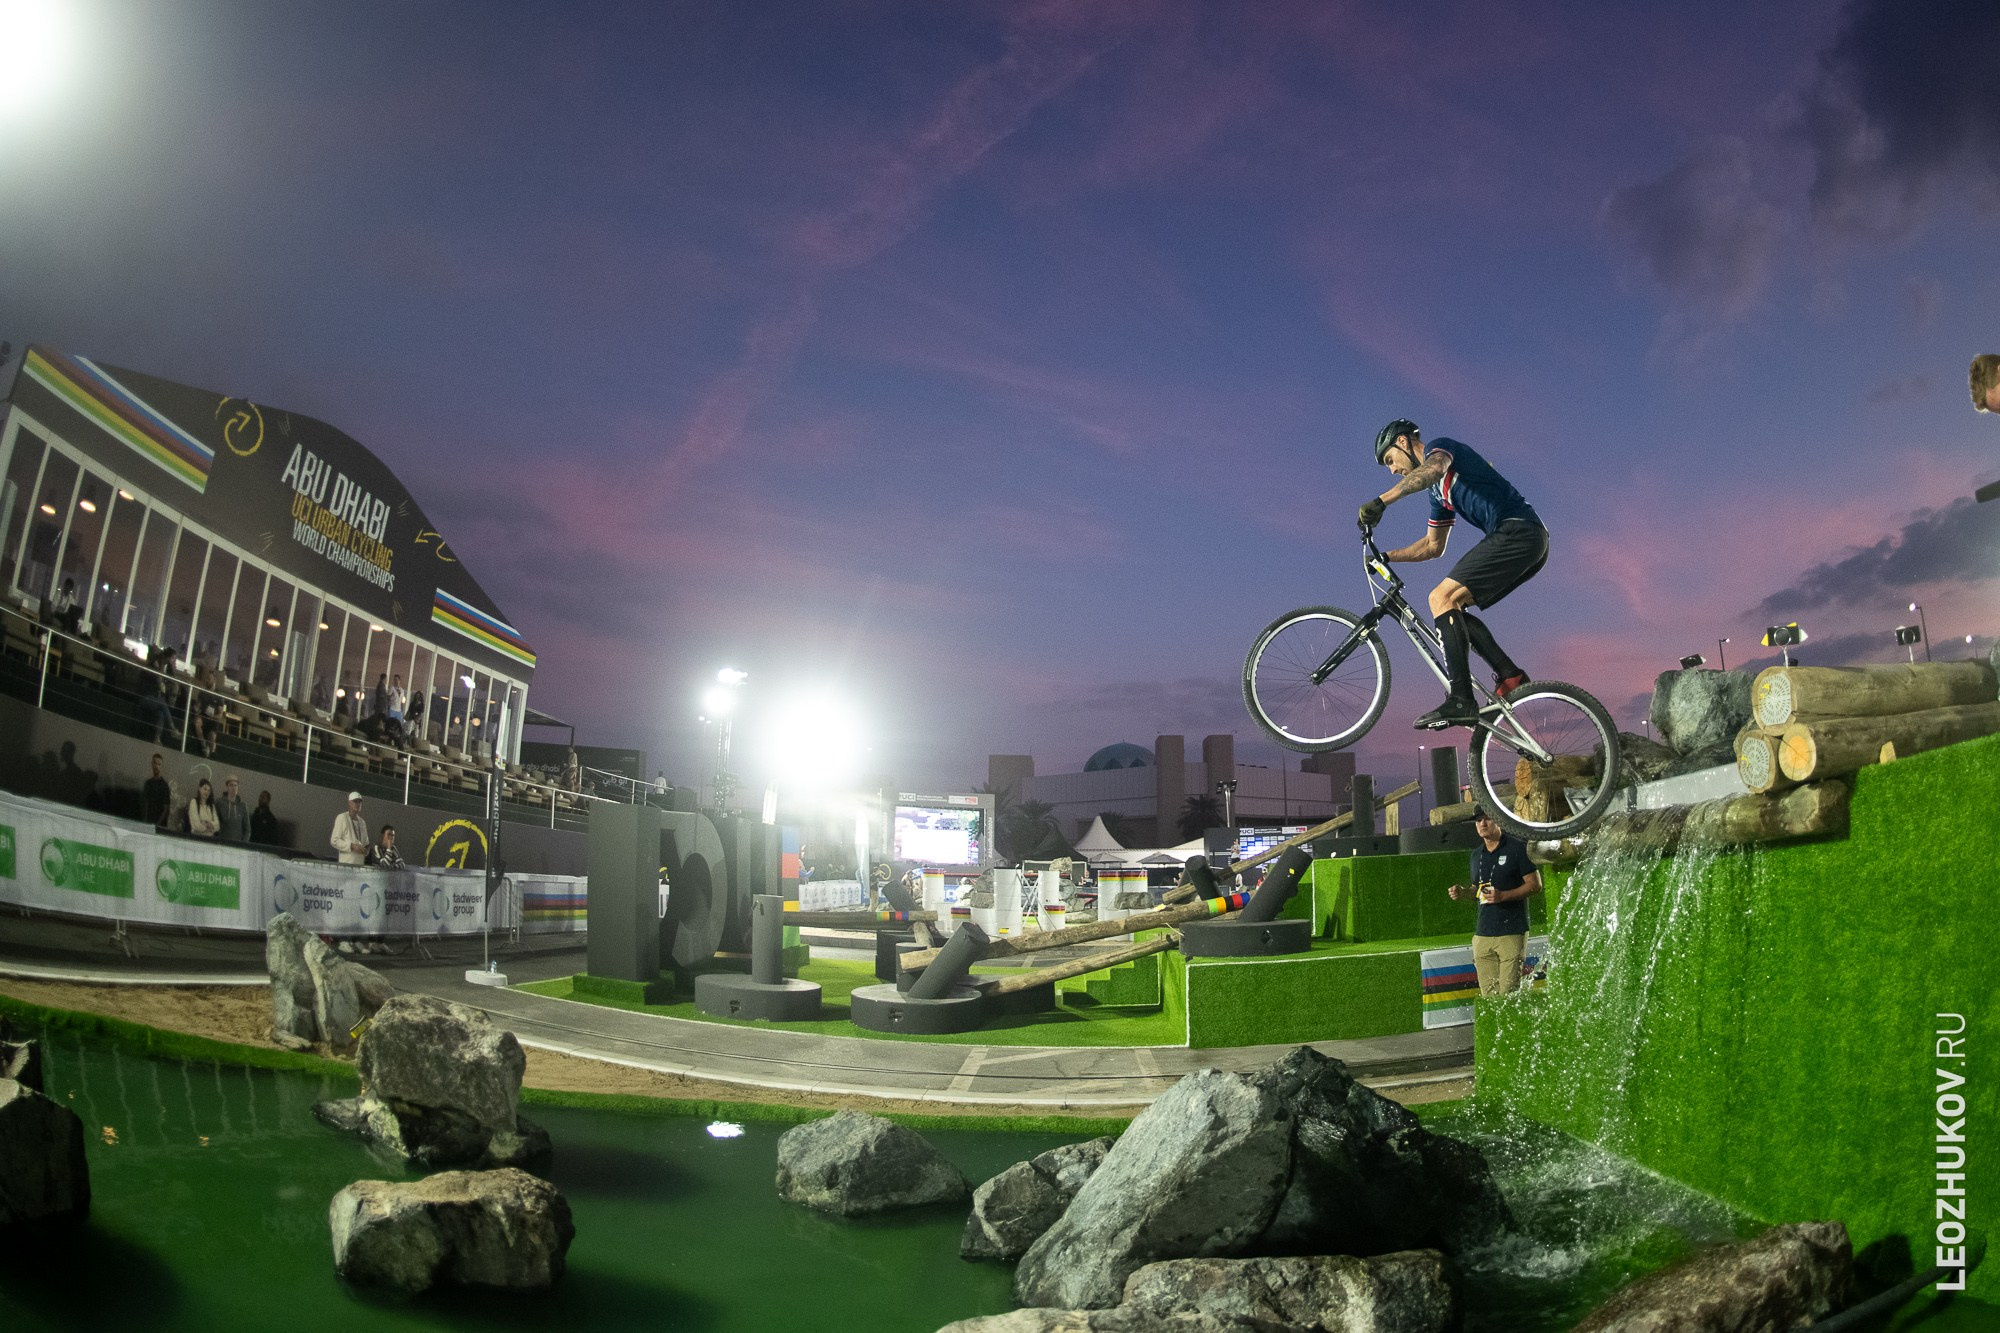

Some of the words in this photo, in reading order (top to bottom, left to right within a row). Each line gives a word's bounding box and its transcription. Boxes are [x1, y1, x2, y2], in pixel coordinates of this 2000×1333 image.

[281, 443, 332, 504] ABU
[329, 472, 391, 543] DHABI
[291, 492, 314, 524] UCI
[312, 504, 351, 546] URBAN
[351, 529, 393, 572] CYCLING
[292, 519, 327, 555] WORLD
[326, 540, 396, 593] CHAMPIONSHIPS
[75, 852, 97, 867] ABU
[99, 856, 130, 872] DHABI
[187, 871, 207, 883] ABU
[208, 874, 237, 887] DHABI
[302, 883, 344, 899] tadweer
[384, 889, 420, 903] tadweer
[453, 892, 483, 904] tadweer
[303, 898, 333, 913] group
[385, 901, 411, 916] group
[453, 903, 475, 917] group
